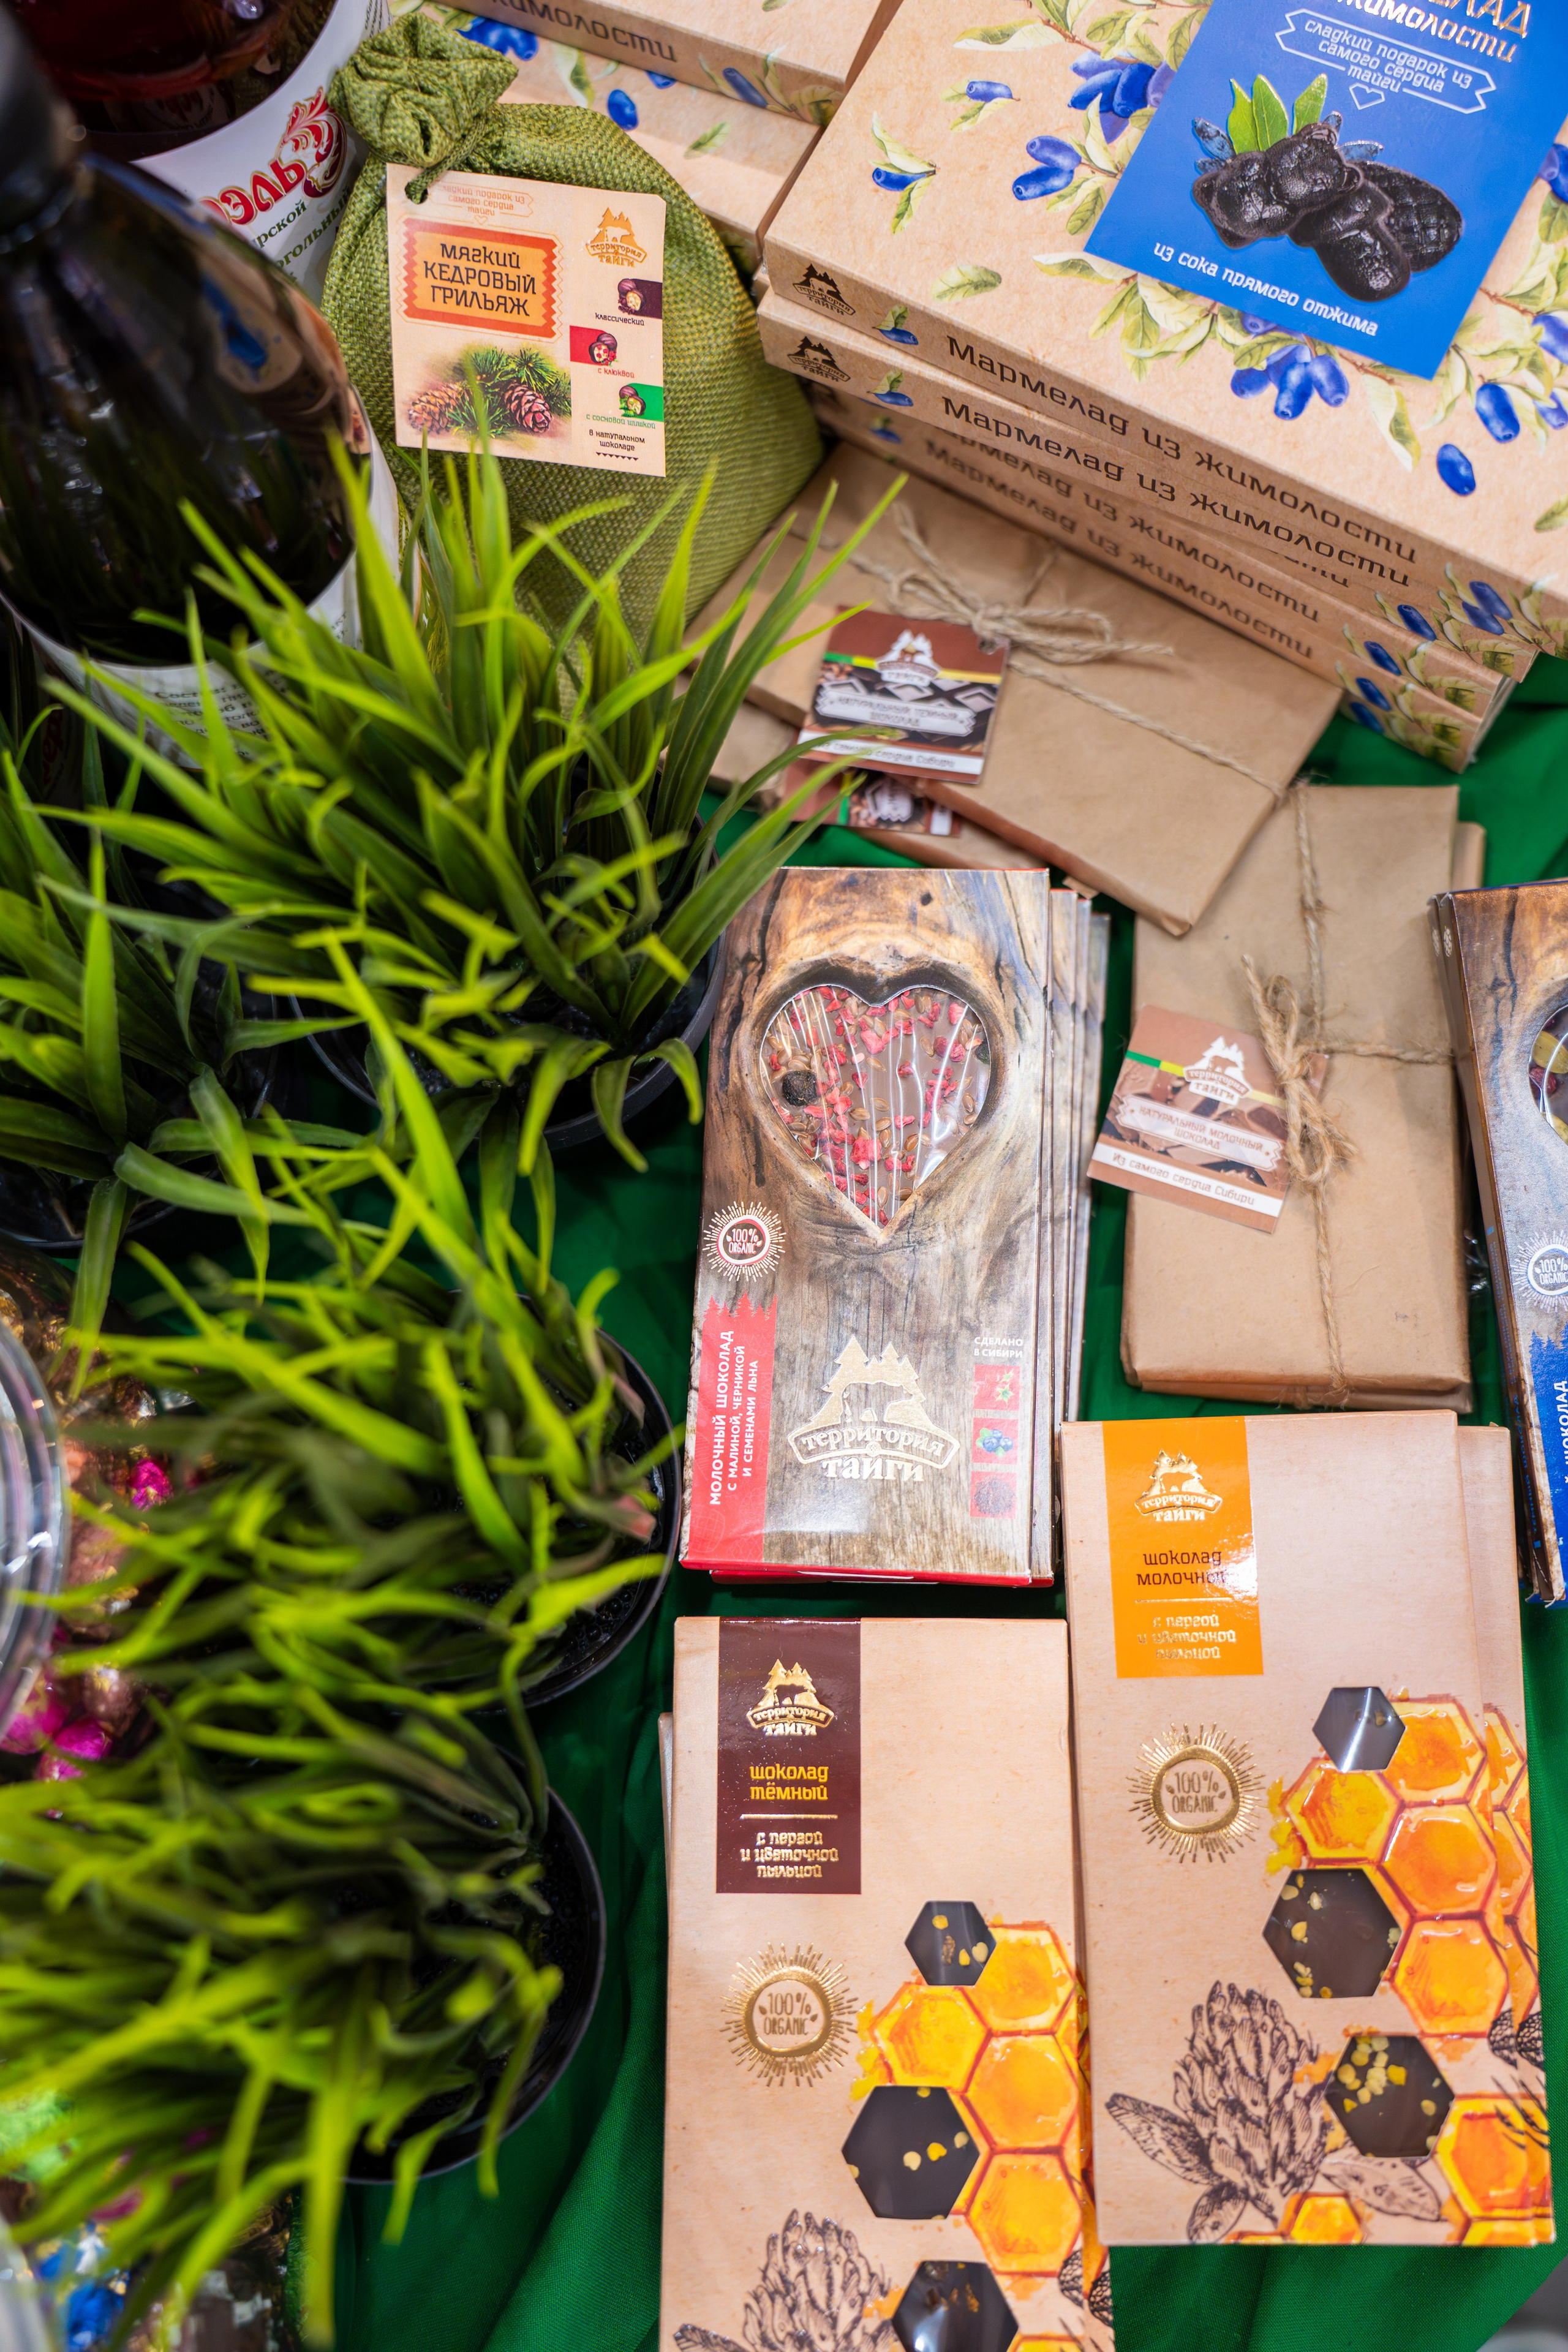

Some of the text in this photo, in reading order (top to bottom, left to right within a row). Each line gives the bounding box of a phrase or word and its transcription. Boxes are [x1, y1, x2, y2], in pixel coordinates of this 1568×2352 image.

[1305, 19, 1472, 89] сладкий подарок из
[1318, 39, 1444, 93] самого сердца
[1349, 64, 1402, 93] тайги
[424, 260, 536, 295] КЕДРОВЫЙ
[1153, 243, 1379, 336] из сока прямого отжима
[431, 285, 530, 317] ГРИЛЬЯЖ
[595, 312, 645, 326] классический
[604, 368, 635, 378] клюквой
[592, 415, 626, 424] сосновой
[627, 420, 655, 429] шишкой
[596, 431, 646, 443] натуральном
[600, 441, 635, 451] шоколаде
[946, 335, 1416, 564] Мармелад из жимолости
[941, 396, 1124, 482] Мармелад
[1136, 473, 1176, 502] из
[1189, 492, 1409, 587] жимолости
[1084, 492, 1117, 522] из
[1129, 515, 1319, 623] жимолости
[1087, 529, 1121, 558] из
[1131, 552, 1313, 660] жимолости
[1139, 1106, 1263, 1152] НАТУРАЛЬНЫЙ МОЛОЧНЫЙ
[1174, 1128, 1220, 1150] ШОКОЛАД
[1113, 1152, 1254, 1206] Из самого сердца Сибири
[732, 1228, 759, 1242] 100%
[729, 1242, 756, 1254] ORGANIC
[974, 1336, 1024, 1348] СДЕЛАНО
[982, 1349, 1023, 1359] СИБИРИ
[733, 1346, 745, 1411] ЧЕРНИКОЙ
[710, 1330, 734, 1505] МОЛОЧНЫЙ ШОКОЛАД
[742, 1360, 758, 1477] И СЕМЕНАМИ ЛЬНА
[1144, 1550, 1222, 1566] шоколад
[1153, 1616, 1161, 1627] с
[750, 1765, 829, 1782] шоколад
[1175, 1771, 1218, 1793] 100%
[750, 1782, 828, 1800] тёмный
[1172, 1795, 1218, 1814] ORGANIC
[756, 1831, 823, 1847] с пергой
[740, 1846, 839, 1862] и цветочной
[756, 1864, 822, 1878] пыльцой
[767, 1992, 811, 2015] 100%
[764, 2016, 809, 2035] ORGANIC
